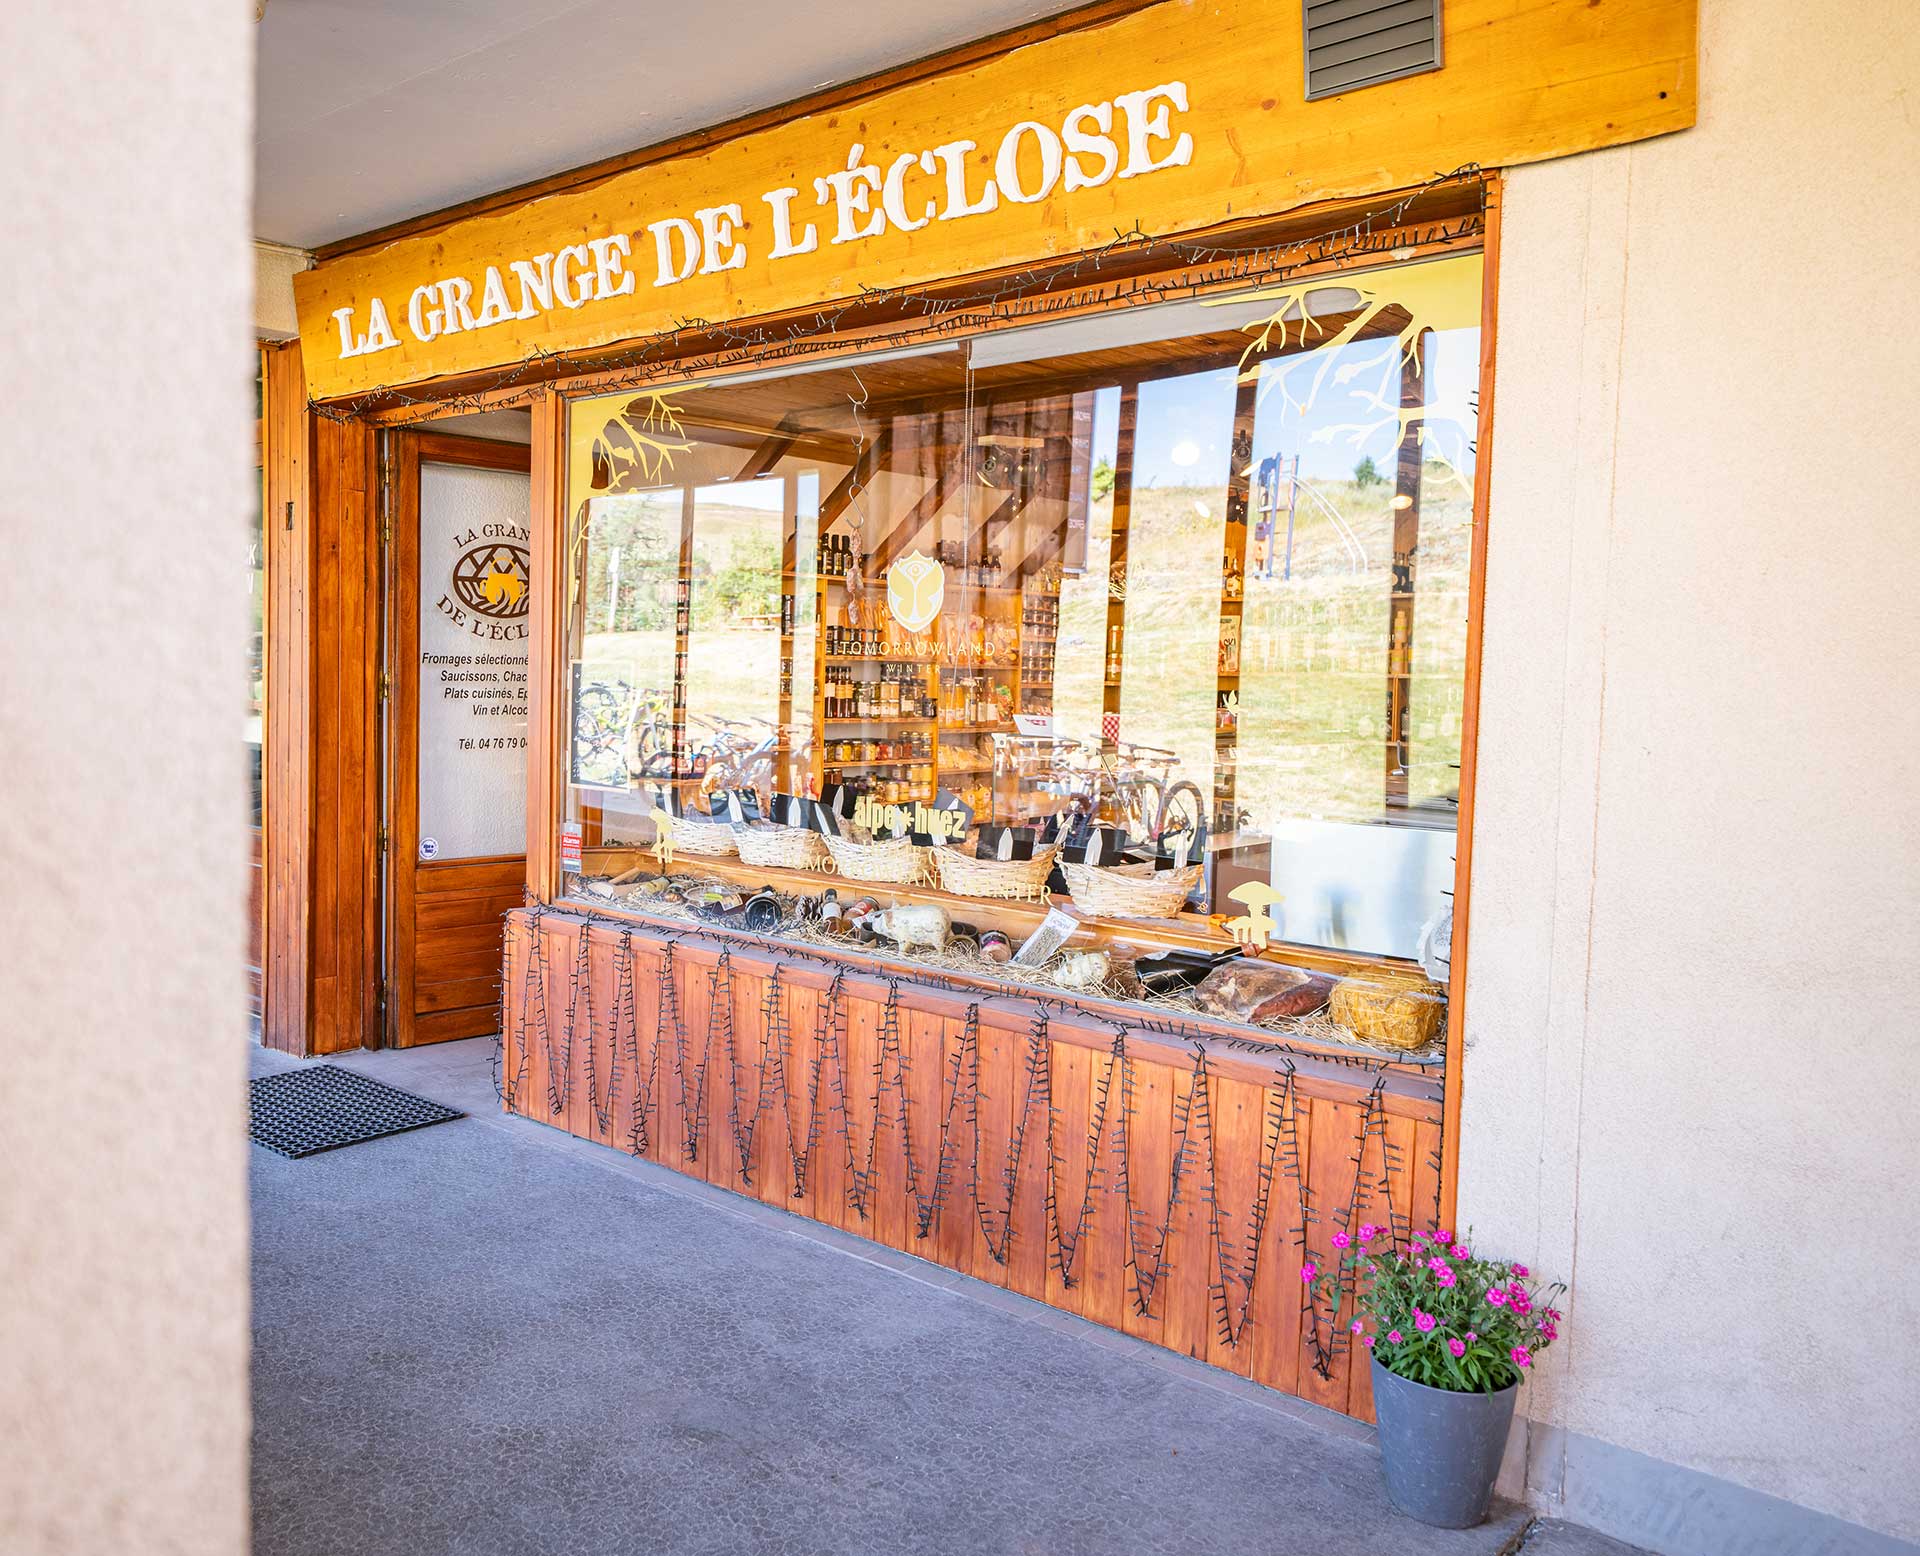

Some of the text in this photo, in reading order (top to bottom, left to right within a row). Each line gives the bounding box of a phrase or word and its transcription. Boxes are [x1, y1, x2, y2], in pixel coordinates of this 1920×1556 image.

[332, 80, 1194, 359] LA GRANGE DE L'ÉCLOSE
[453, 523, 530, 549] LA GRAN
[436, 594, 467, 627] DE
[840, 641, 996, 657] TOMORROWLAND
[422, 652, 472, 667] Fromages
[886, 663, 941, 674] WINTER
[440, 670, 500, 682] Saucissons,
[444, 688, 469, 699] Plats
[472, 687, 514, 700] cuisinés,
[472, 705, 488, 716] Vin
[490, 705, 500, 716] et
[459, 737, 528, 750] Tél. 04 76 79 0
